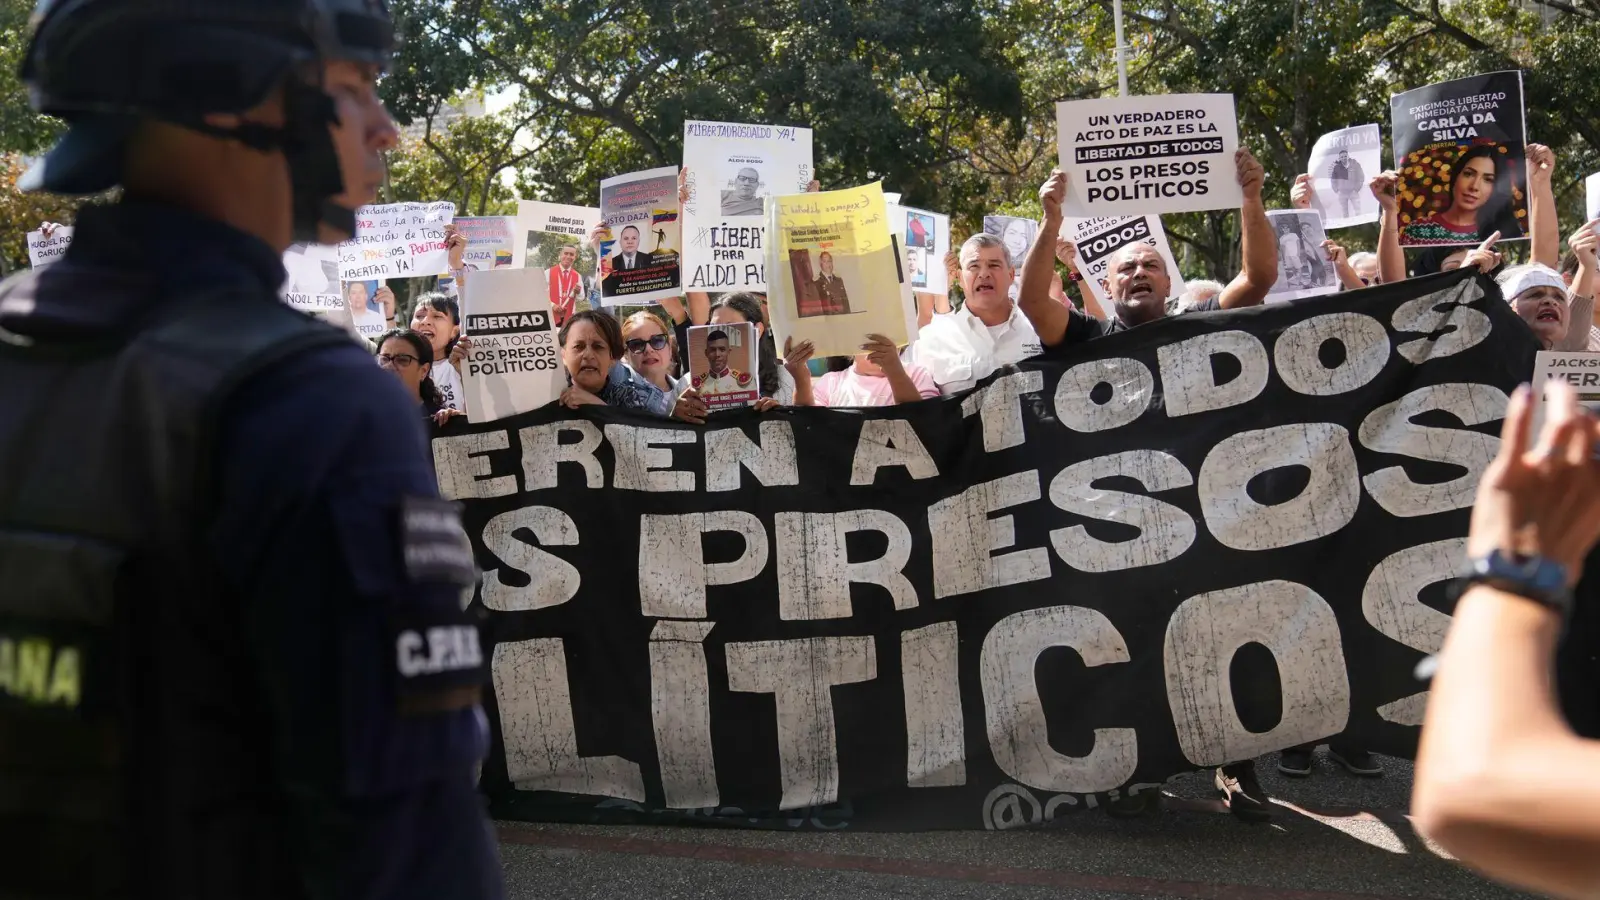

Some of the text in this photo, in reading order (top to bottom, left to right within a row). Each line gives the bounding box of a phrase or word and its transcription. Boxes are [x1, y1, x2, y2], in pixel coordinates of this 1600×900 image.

[1409, 91, 1506, 115] EXIGIMOS LIBERTAD
[1414, 101, 1499, 120] INMEDIATA PARA
[1088, 109, 1206, 127] UN VERDADERO
[1417, 112, 1497, 131] CARLA DA
[1075, 122, 1218, 142] ACTO DE PAZ ES LA
[1432, 127, 1478, 142] SILVA
[1077, 140, 1222, 161] LIBERTAD DE TODOS
[1086, 160, 1210, 183] LOS PRESOS
[1087, 179, 1209, 203] POLÍTICOS
[628, 212, 649, 222] DAZA
[1074, 219, 1118, 241] LIBERTAD
[1080, 221, 1147, 258] TODOS
[467, 251, 492, 260] DAZA
[713, 249, 745, 261] PARA
[340, 264, 389, 279] IBERTAD
[688, 264, 736, 288] ALDO
[1087, 260, 1107, 276] LOS
[466, 313, 545, 331] LIBERTAD
[503, 333, 553, 346] TODOS
[467, 346, 556, 363] LOS PRESOS
[1548, 358, 1600, 368] JACKS
[469, 358, 558, 377] POLÍTICOS
[849, 418, 940, 486] A
[961, 275, 1493, 453] TODOS
[1547, 372, 1600, 387] VER
[638, 382, 1508, 621] PRESOS
